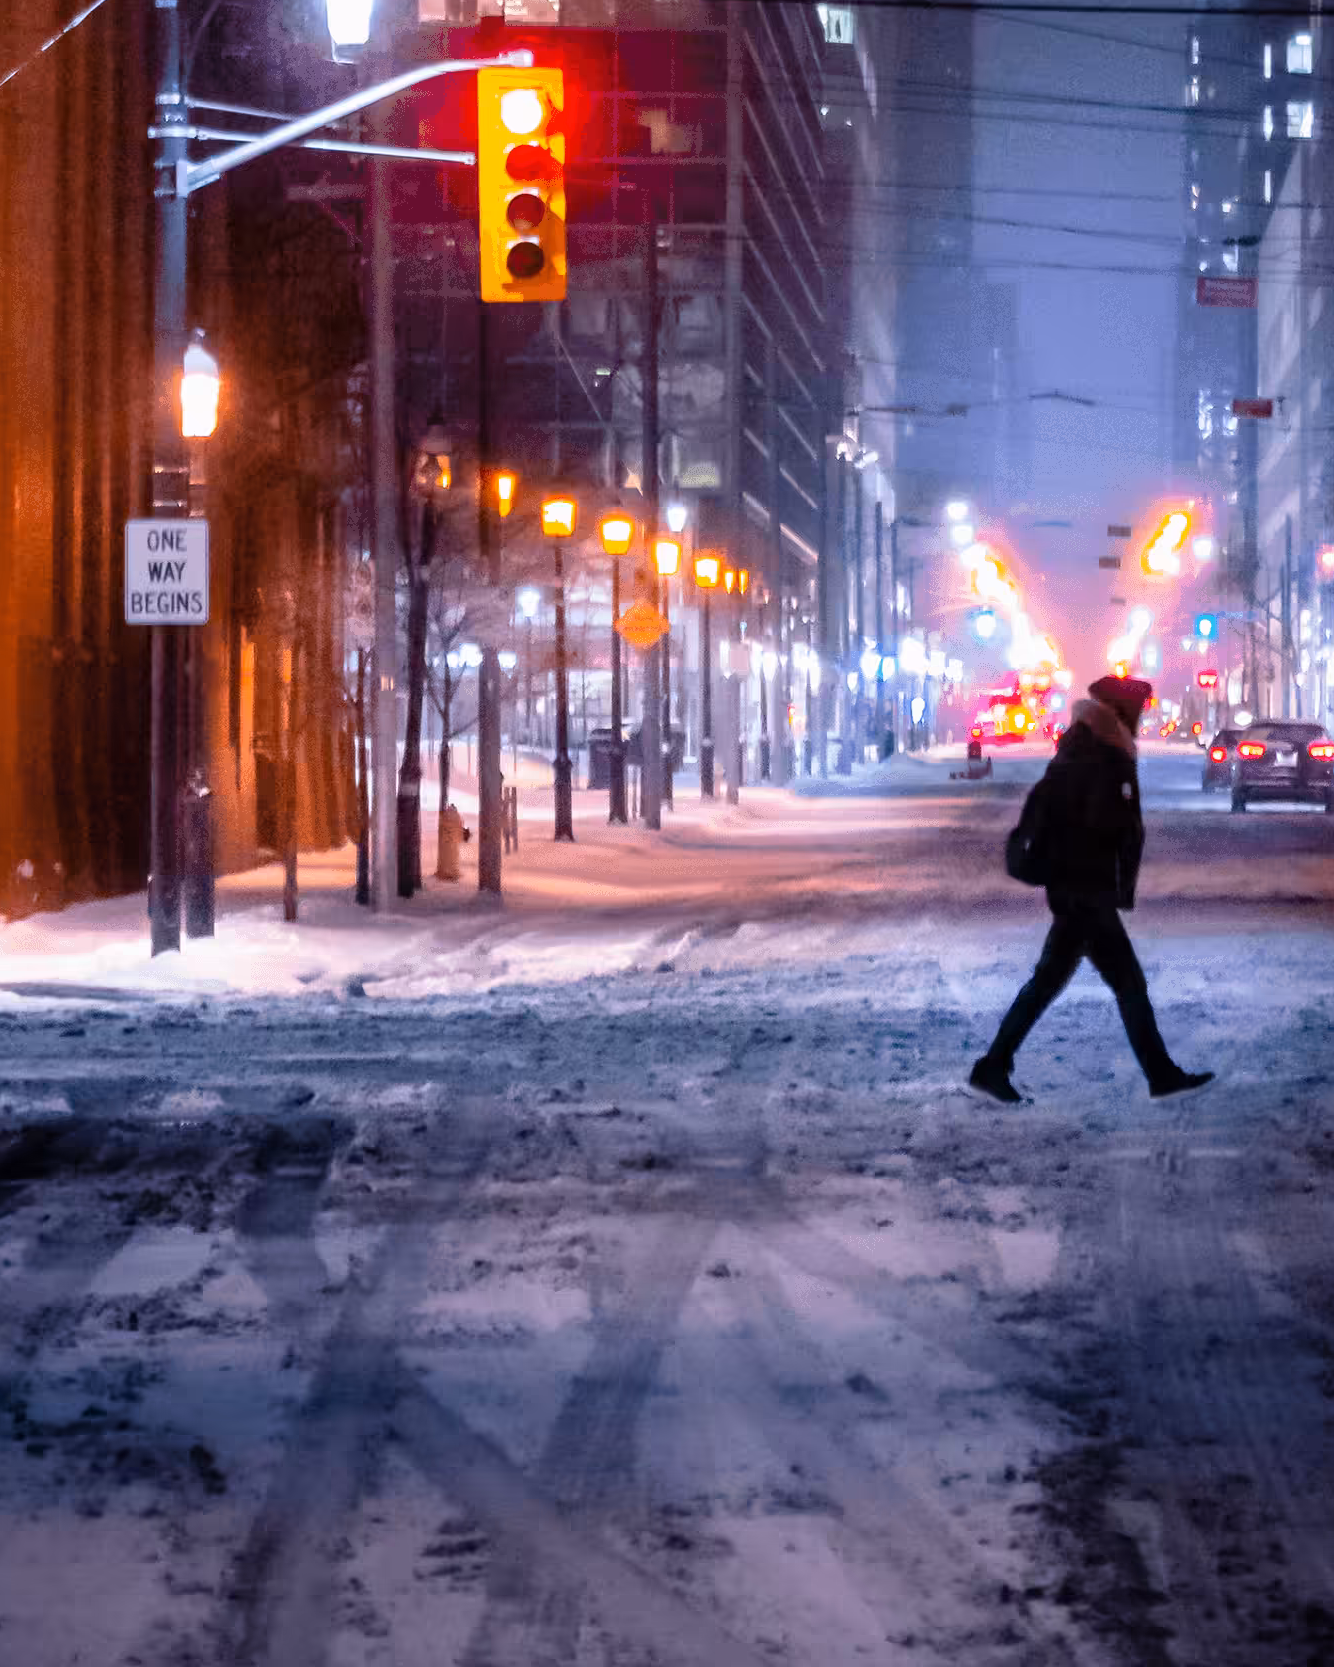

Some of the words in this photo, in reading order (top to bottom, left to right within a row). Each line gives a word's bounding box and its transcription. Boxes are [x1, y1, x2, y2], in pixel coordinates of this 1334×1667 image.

[147, 529, 187, 552] ONE
[148, 561, 186, 582] WAY
[131, 591, 203, 614] BEGINS
